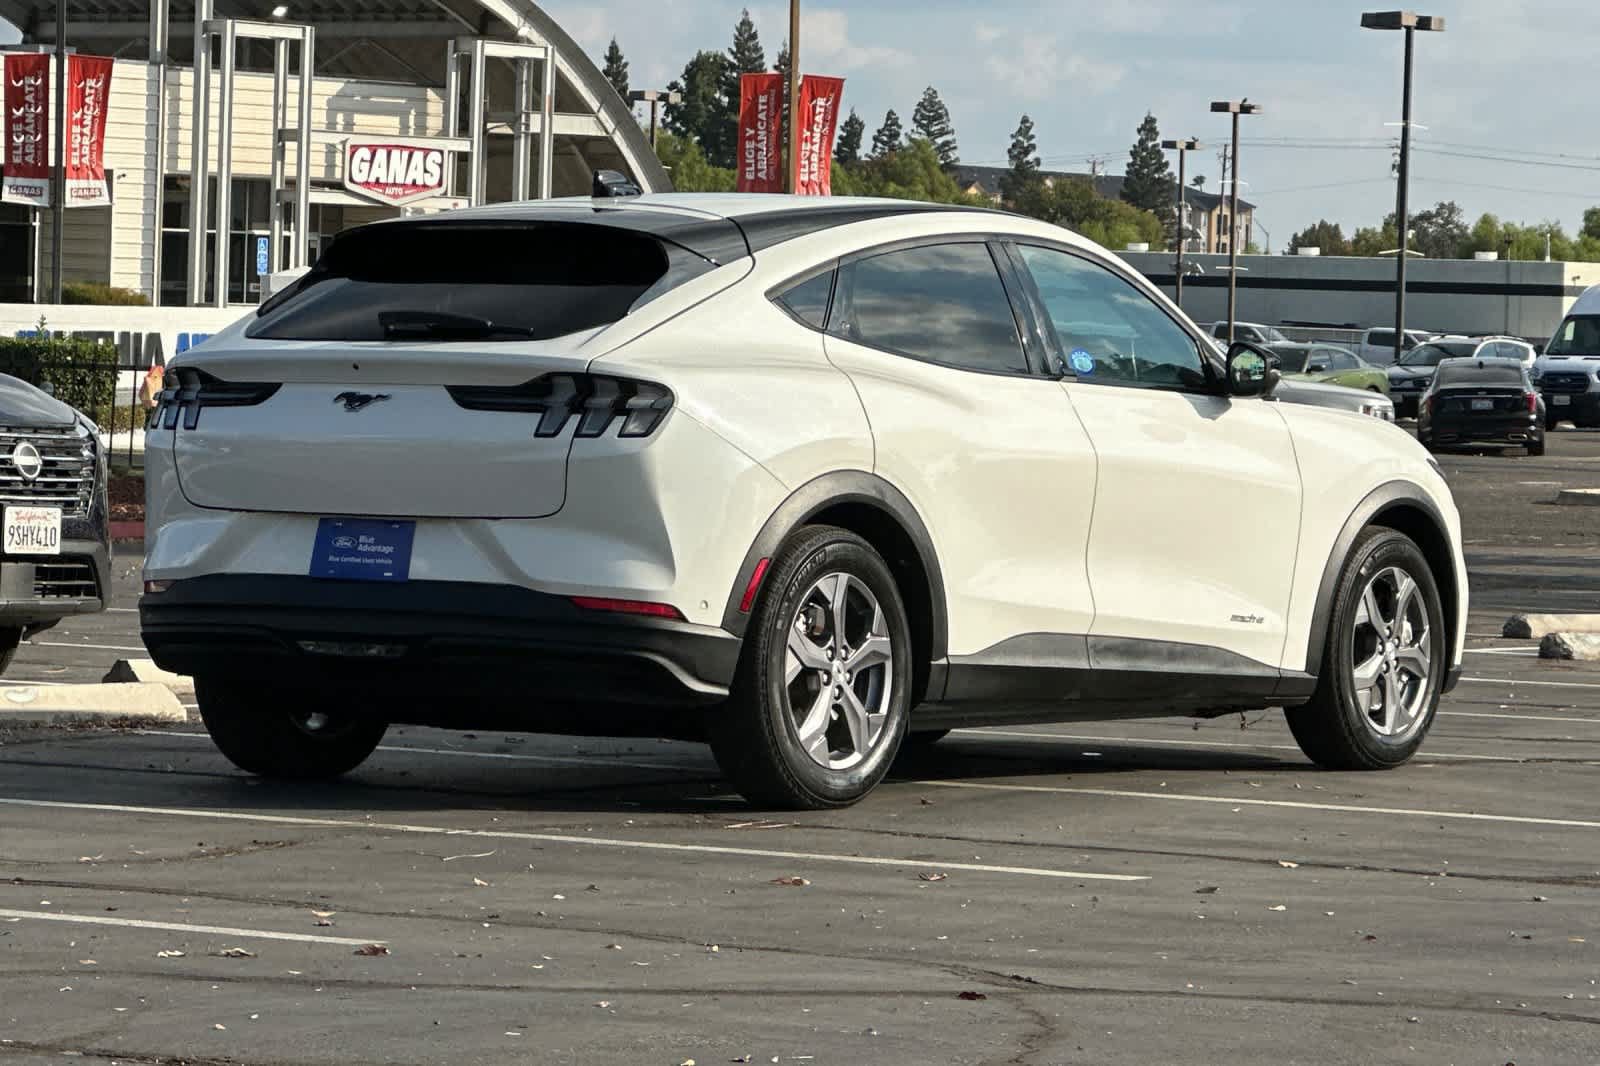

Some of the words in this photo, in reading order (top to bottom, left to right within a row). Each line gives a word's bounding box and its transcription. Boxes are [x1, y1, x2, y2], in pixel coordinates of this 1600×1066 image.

[746, 127, 755, 137] Y
[803, 128, 811, 138] Y
[12, 122, 24, 164] ELIGE
[71, 124, 81, 167] ELIGE
[745, 140, 755, 180] ELIGE
[800, 142, 811, 182] ELIGE
[351, 147, 443, 187] GANAS
[10, 186, 42, 195] GANAS
[71, 187, 101, 196] GANAS
[385, 187, 403, 195] AUTO
[8, 525, 57, 547] 9SHY410
[359, 535, 376, 544] Blue
[357, 544, 395, 554] Advantage
